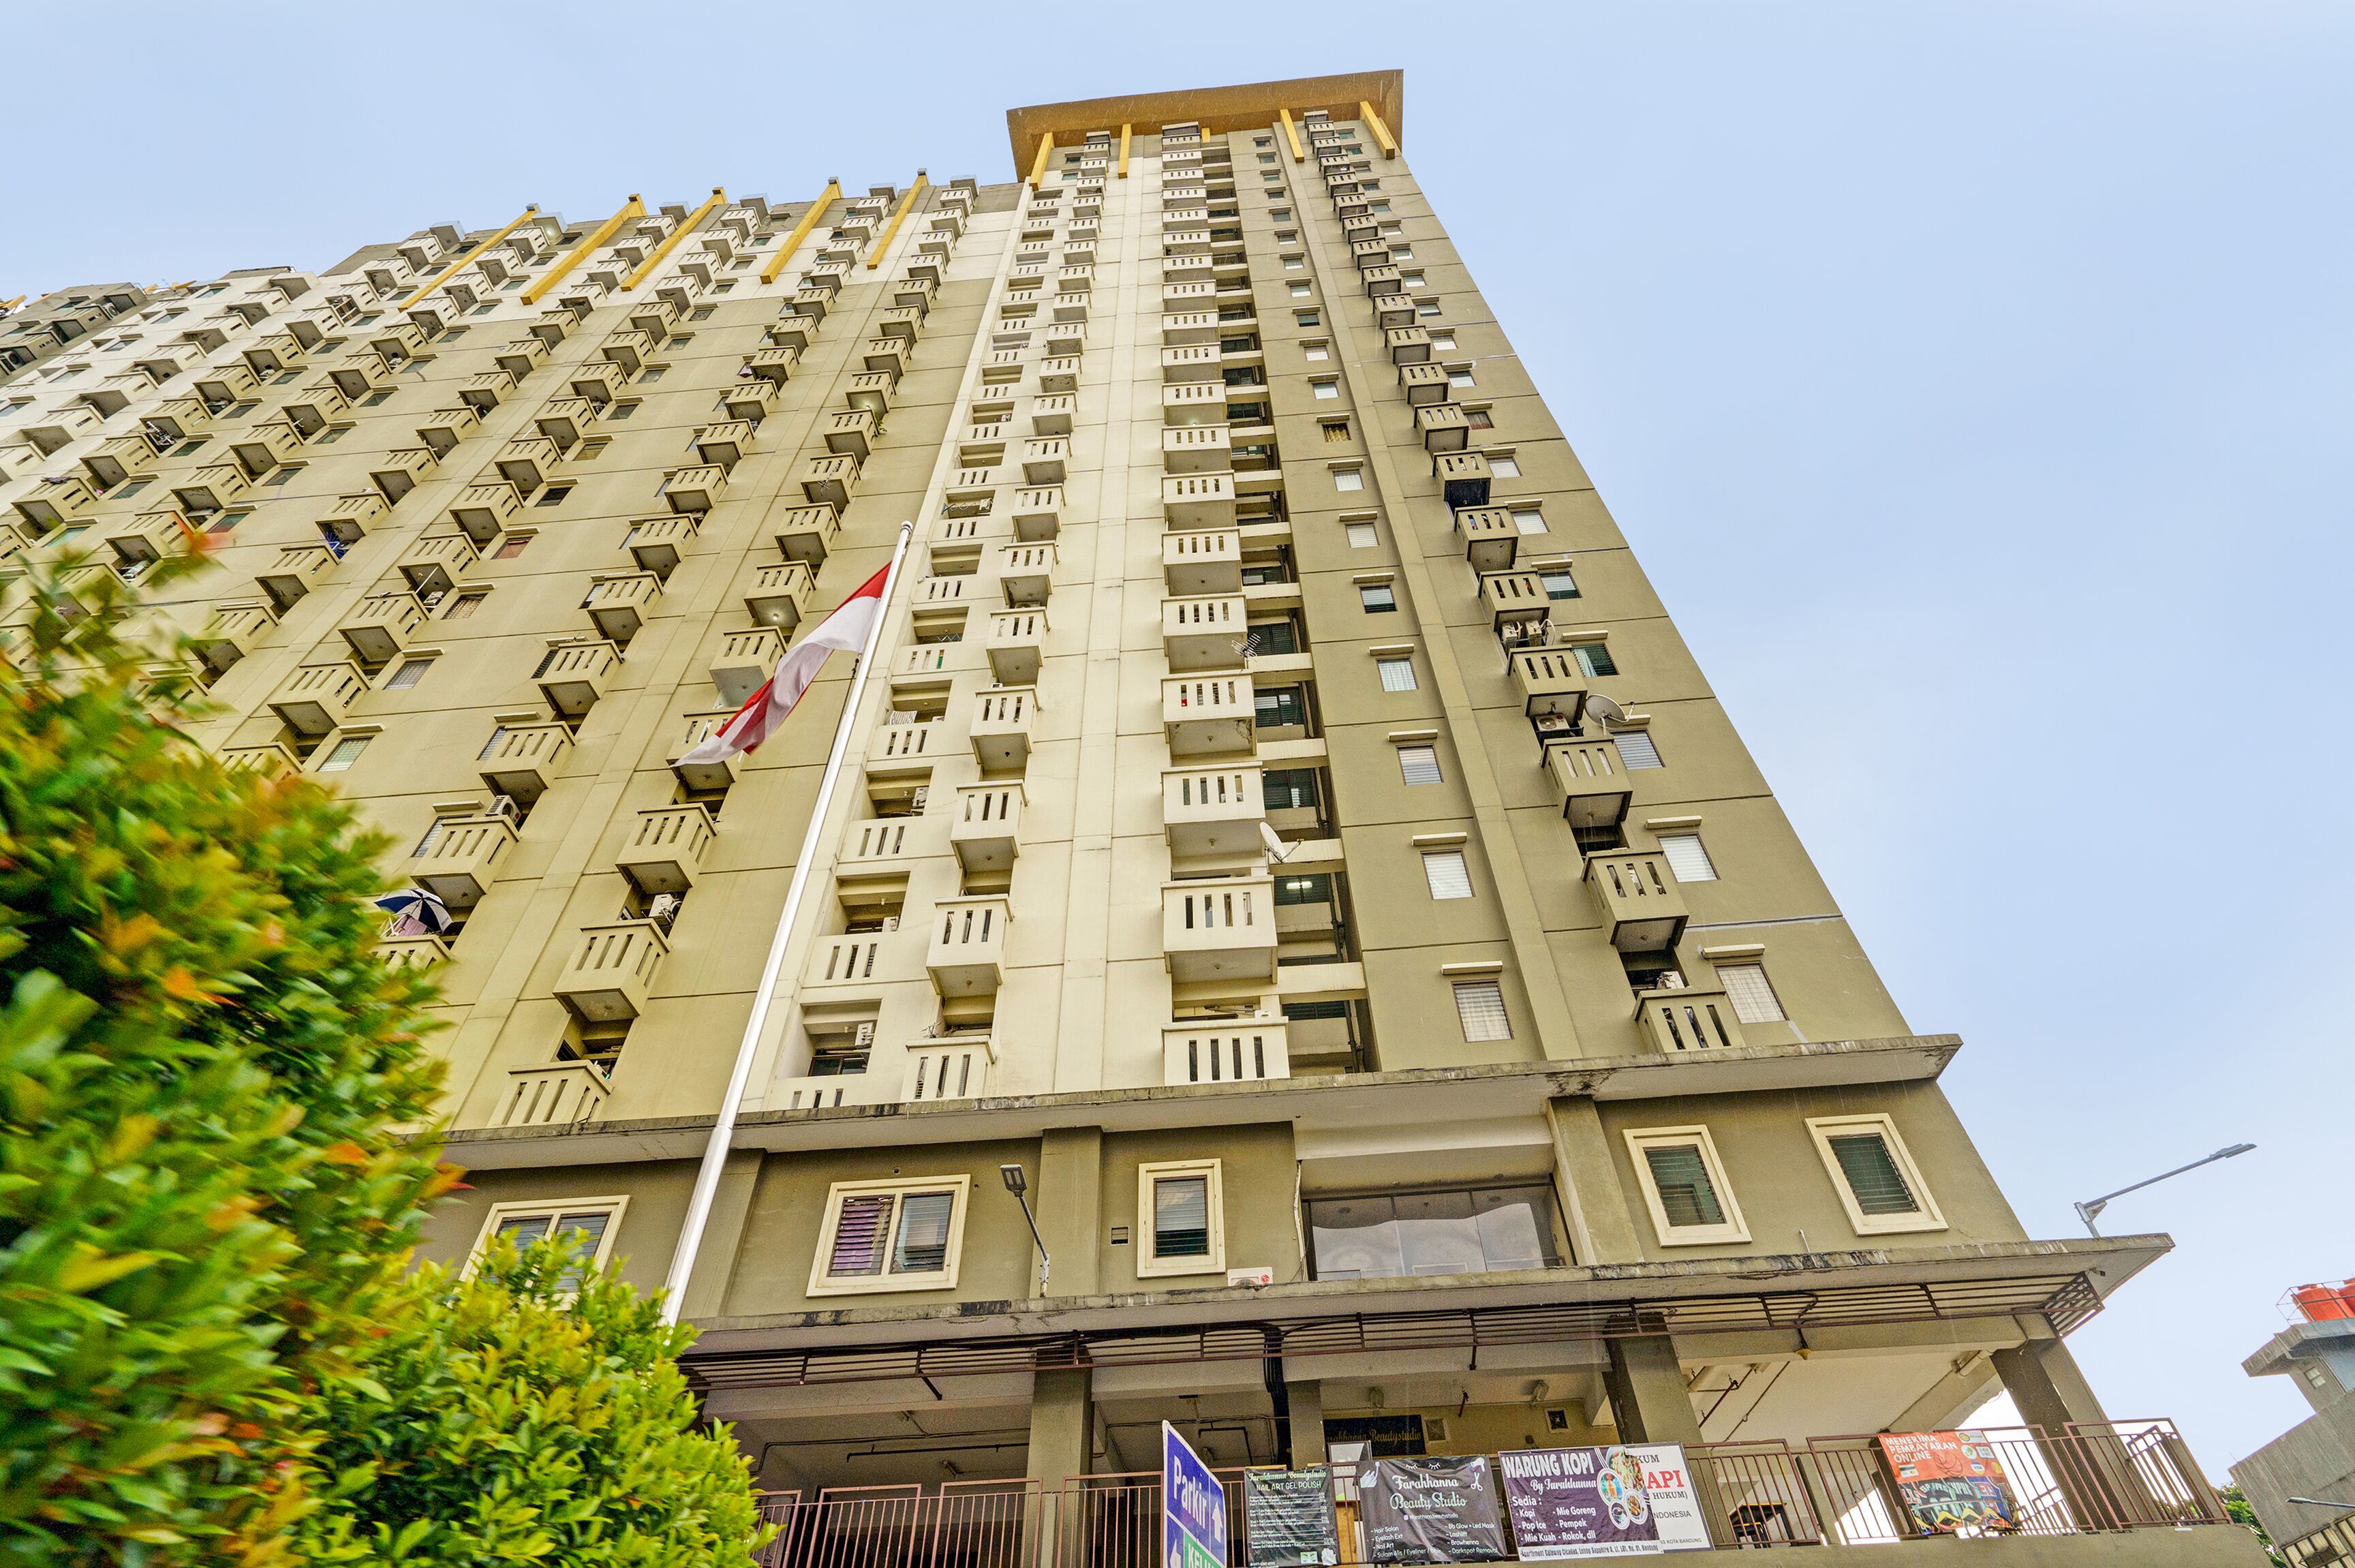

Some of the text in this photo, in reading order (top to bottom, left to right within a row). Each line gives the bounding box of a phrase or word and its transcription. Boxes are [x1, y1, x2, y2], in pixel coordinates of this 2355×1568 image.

[1370, 1428, 1421, 1446] Beautystudio
[1885, 1434, 1937, 1446] MENERIMA
[1888, 1442, 1958, 1454] PEMBAYARAN
[1635, 1454, 1660, 1464] KUM
[1893, 1451, 1931, 1463] ONLINE
[1501, 1451, 1595, 1479] WARUNG KOPI
[1285, 1481, 1297, 1490] GEL
[1298, 1481, 1321, 1489] POLISH
[1391, 1473, 1459, 1490] Farahhanna
[1647, 1470, 1684, 1490] API
[1174, 1455, 1207, 1529] Parkir
[1530, 1479, 1544, 1494] By
[1389, 1491, 1467, 1509] Beauty Studio
[1652, 1491, 1688, 1500] HUKUM)
[1512, 1496, 1537, 1507] Sedia
[1519, 1509, 1535, 1519] Kopi
[1556, 1506, 1596, 1517] Mie Goreng
[1653, 1510, 1692, 1519] NDONESIA
[1522, 1520, 1547, 1532] Pop Ice
[1558, 1518, 1588, 1529] Pempek
[1375, 1534, 1394, 1542] Eyelash
[1524, 1532, 1556, 1542] Mie Kuah
[1562, 1531, 1586, 1541] Rokok,
